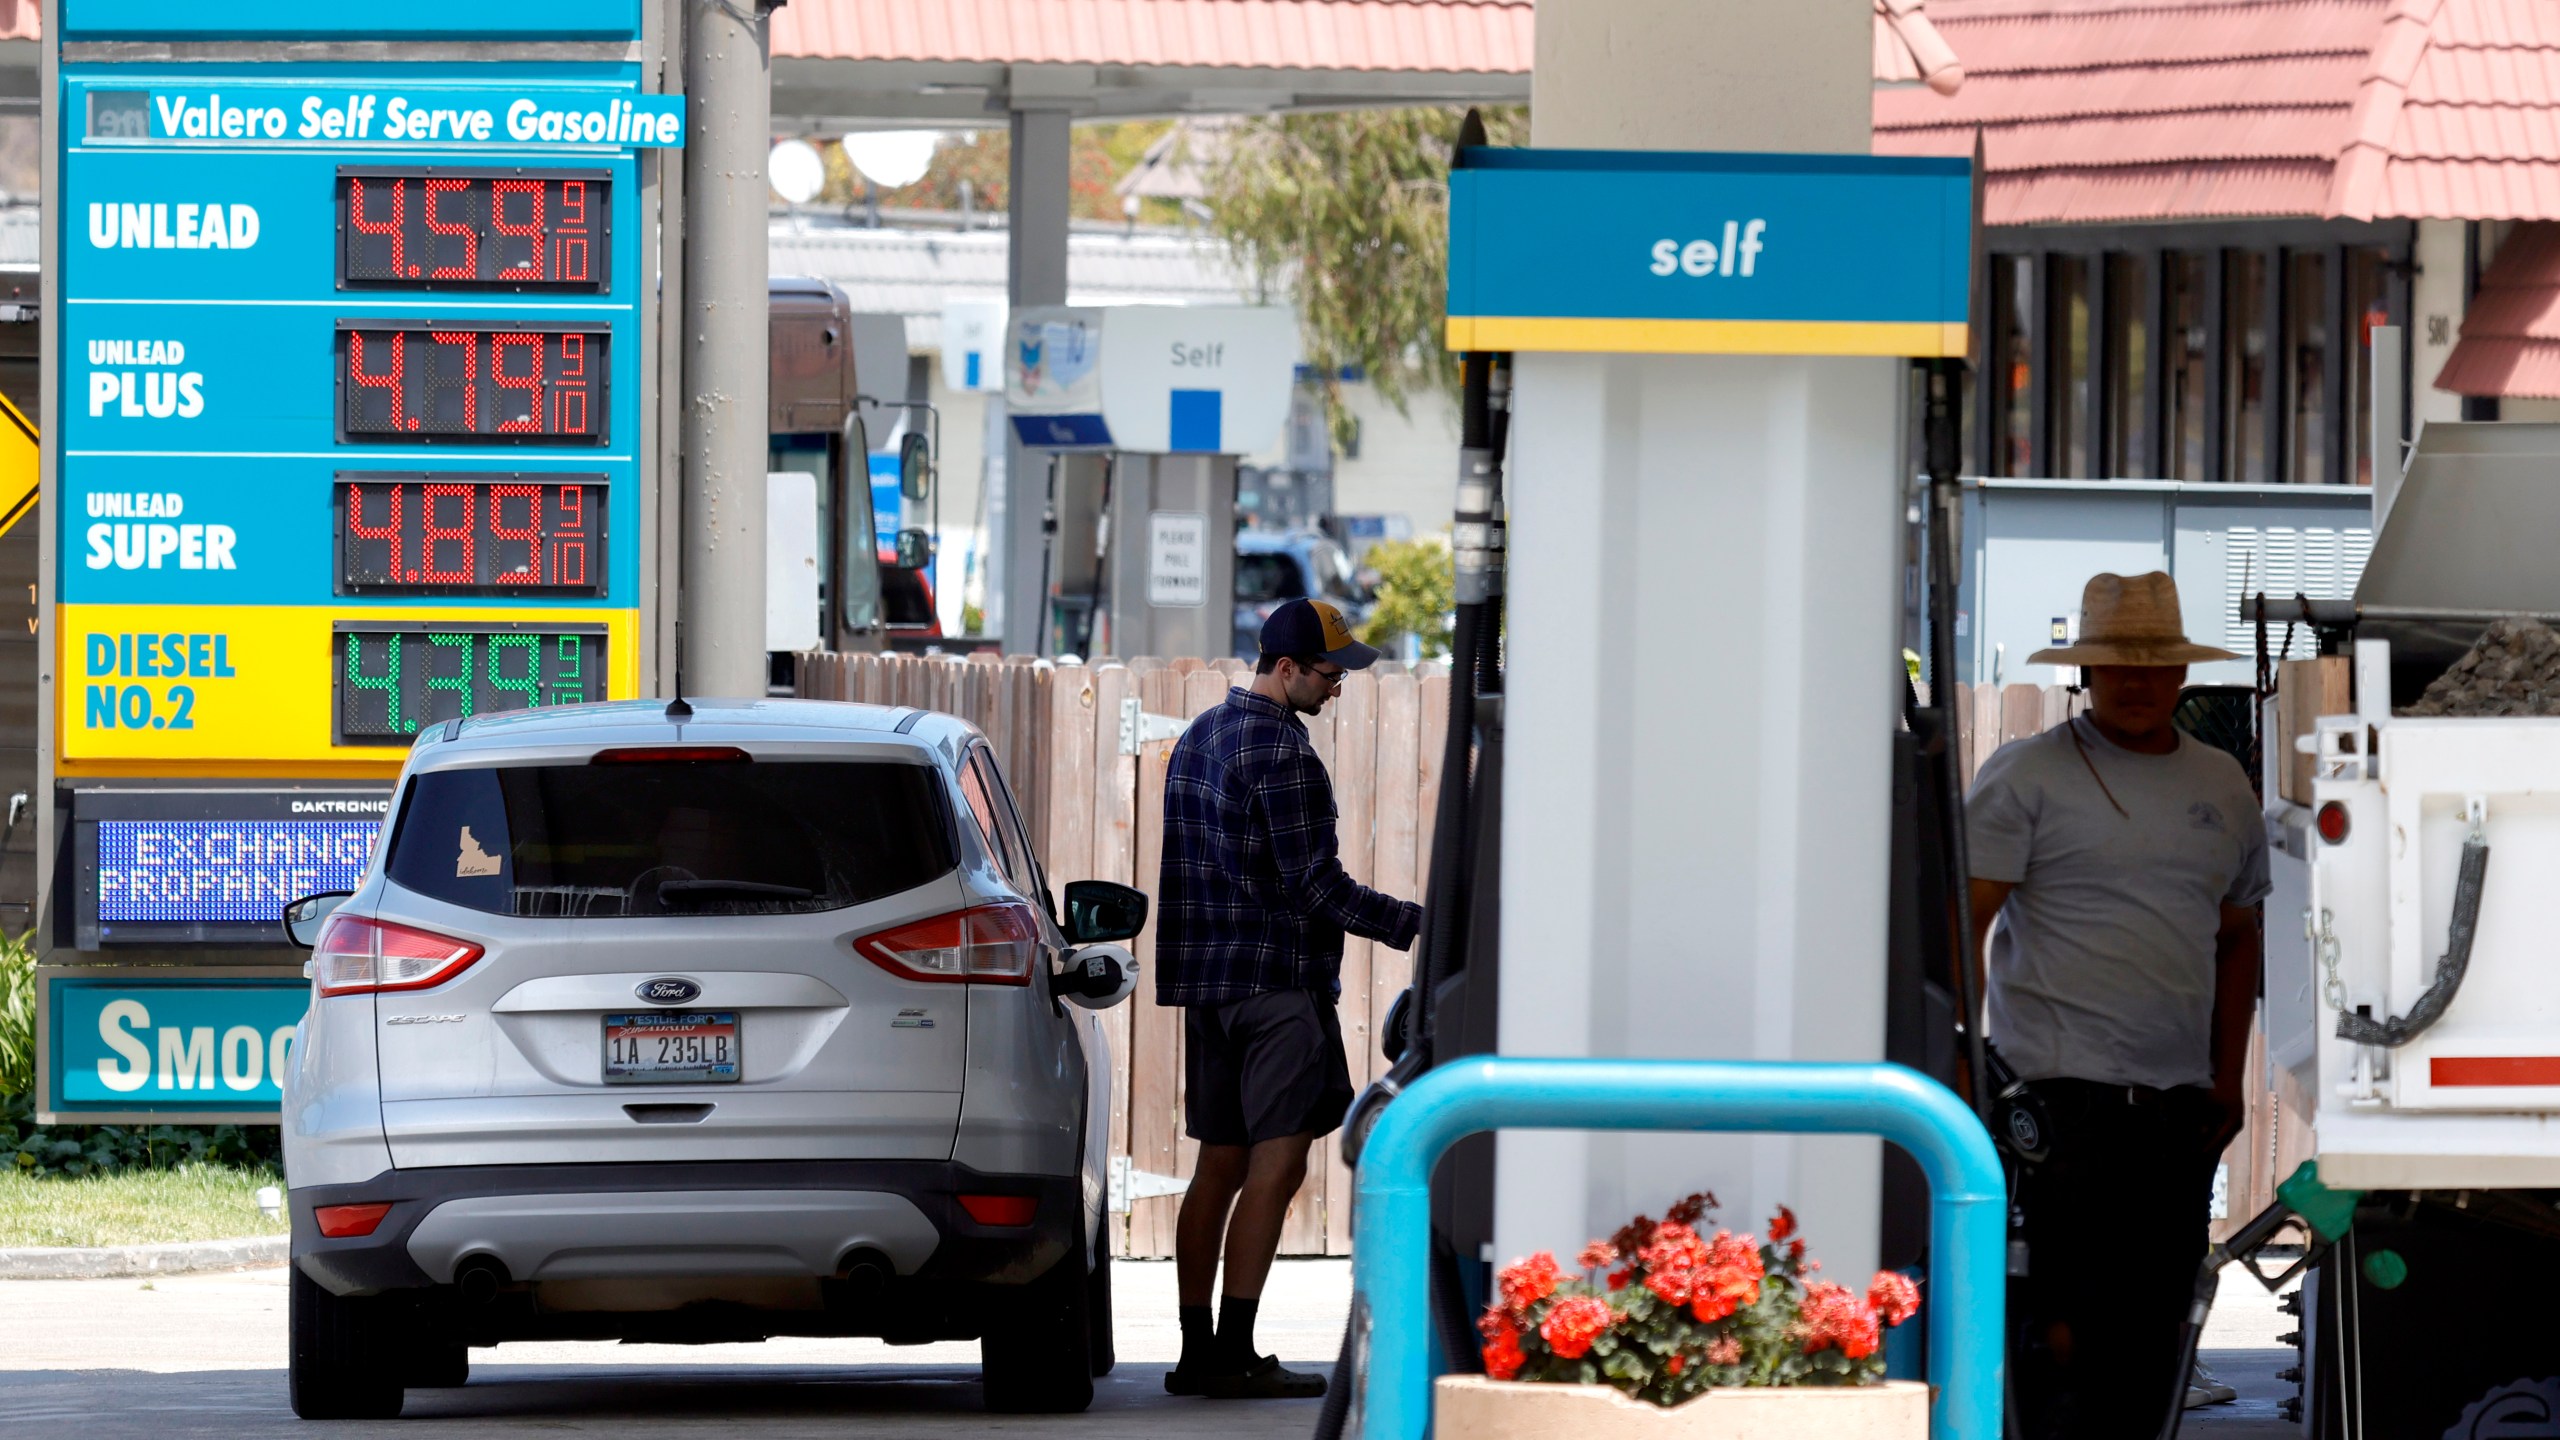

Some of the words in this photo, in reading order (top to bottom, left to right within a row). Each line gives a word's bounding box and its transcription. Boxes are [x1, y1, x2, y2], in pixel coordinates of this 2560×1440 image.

[156, 94, 287, 138] Valero
[298, 95, 377, 139] Self
[383, 97, 494, 140] Serve
[507, 98, 681, 144] Gasoline
[89, 203, 260, 249] UNLEAD
[352, 178, 544, 280] 4.59
[1650, 218, 1767, 277] self
[88, 340, 185, 365] UNLEAD
[1170, 340, 1224, 369] Self
[89, 371, 205, 418] PLUS
[351, 331, 543, 433] 4.79
[86, 492, 184, 518] UNLEAD
[86, 523, 237, 570] SUPER
[350, 483, 542, 584] 4.89
[1159, 530, 1196, 546] PLEASE
[86, 633, 236, 678] DIESEL
[348, 633, 540, 734] 4.39
[86, 684, 195, 730] NO.2
[99, 868, 317, 901] PROPANE
[651, 983, 686, 998] Ford
[386, 1014, 466, 1025] ESCAPE
[613, 1037, 639, 1065] 1A
[658, 1035, 727, 1065] 235LB
